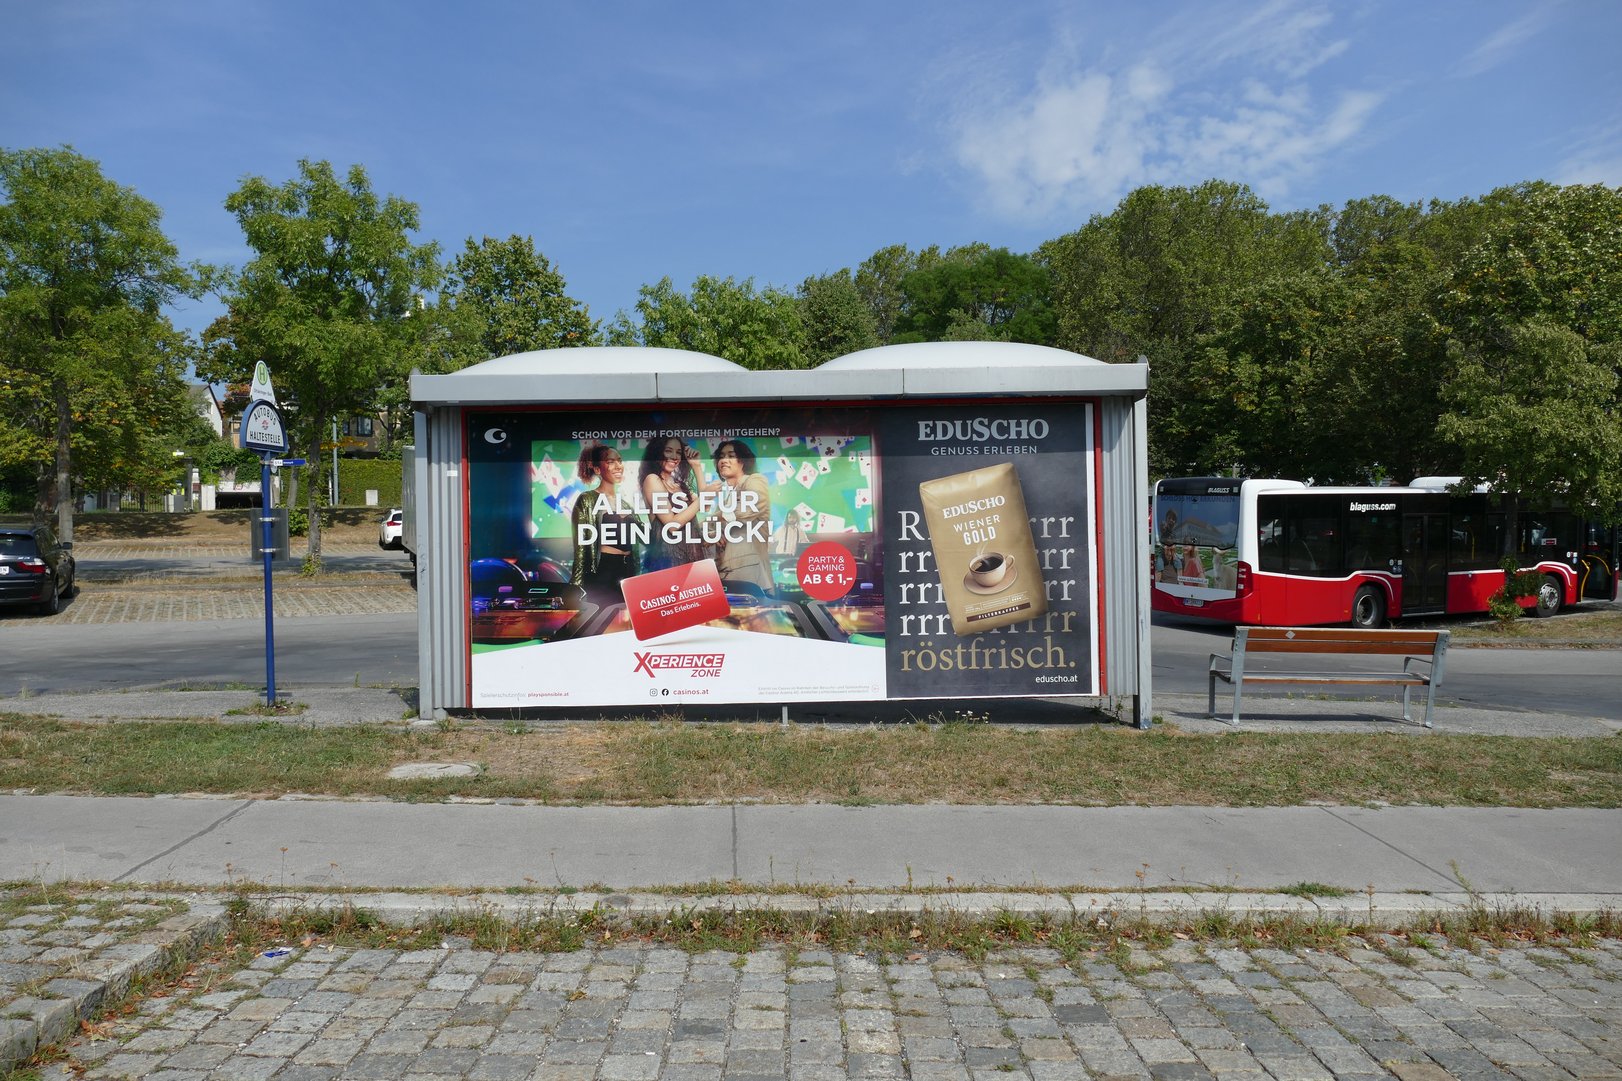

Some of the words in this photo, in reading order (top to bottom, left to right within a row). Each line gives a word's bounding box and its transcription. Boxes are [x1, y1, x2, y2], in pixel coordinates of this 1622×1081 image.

[254, 407, 276, 426] AUTOBUS
[572, 430, 608, 439] SCHON
[611, 430, 632, 439] VOR
[635, 430, 657, 438] DEM
[660, 429, 720, 438] FORTGEHEN
[723, 428, 781, 437] MITGEHEN?
[918, 417, 1049, 441] EDUSCHO
[249, 431, 281, 444] HALTESTELLE
[931, 446, 979, 455] GENUSS
[984, 445, 1037, 455] ERLEBEN
[592, 492, 688, 515] ALLES
[700, 486, 760, 513] FÜR
[942, 495, 1005, 519] EDUSCHO
[1349, 502, 1396, 513] blaguss.com
[953, 514, 1000, 532] WIENER
[577, 522, 650, 545] DEIN
[661, 517, 775, 544] GLÜCK!
[963, 526, 996, 545] GOLD
[808, 555, 837, 564] PARTY
[838, 555, 845, 563] &
[808, 564, 845, 572] GAMING
[802, 574, 822, 584] AB
[825, 573, 834, 584] €
[640, 594, 676, 611] CASINOS
[679, 583, 713, 600] AUSTRIA
[661, 608, 674, 617] Das
[675, 602, 701, 613] Erlebnis.
[978, 606, 1019, 619] FILTERKAFFEE
[901, 635, 1076, 671] röstfrisch.
[633, 652, 724, 678] XPERIENCE
[691, 669, 721, 678] ZONE
[1035, 674, 1078, 683] eduscho.at
